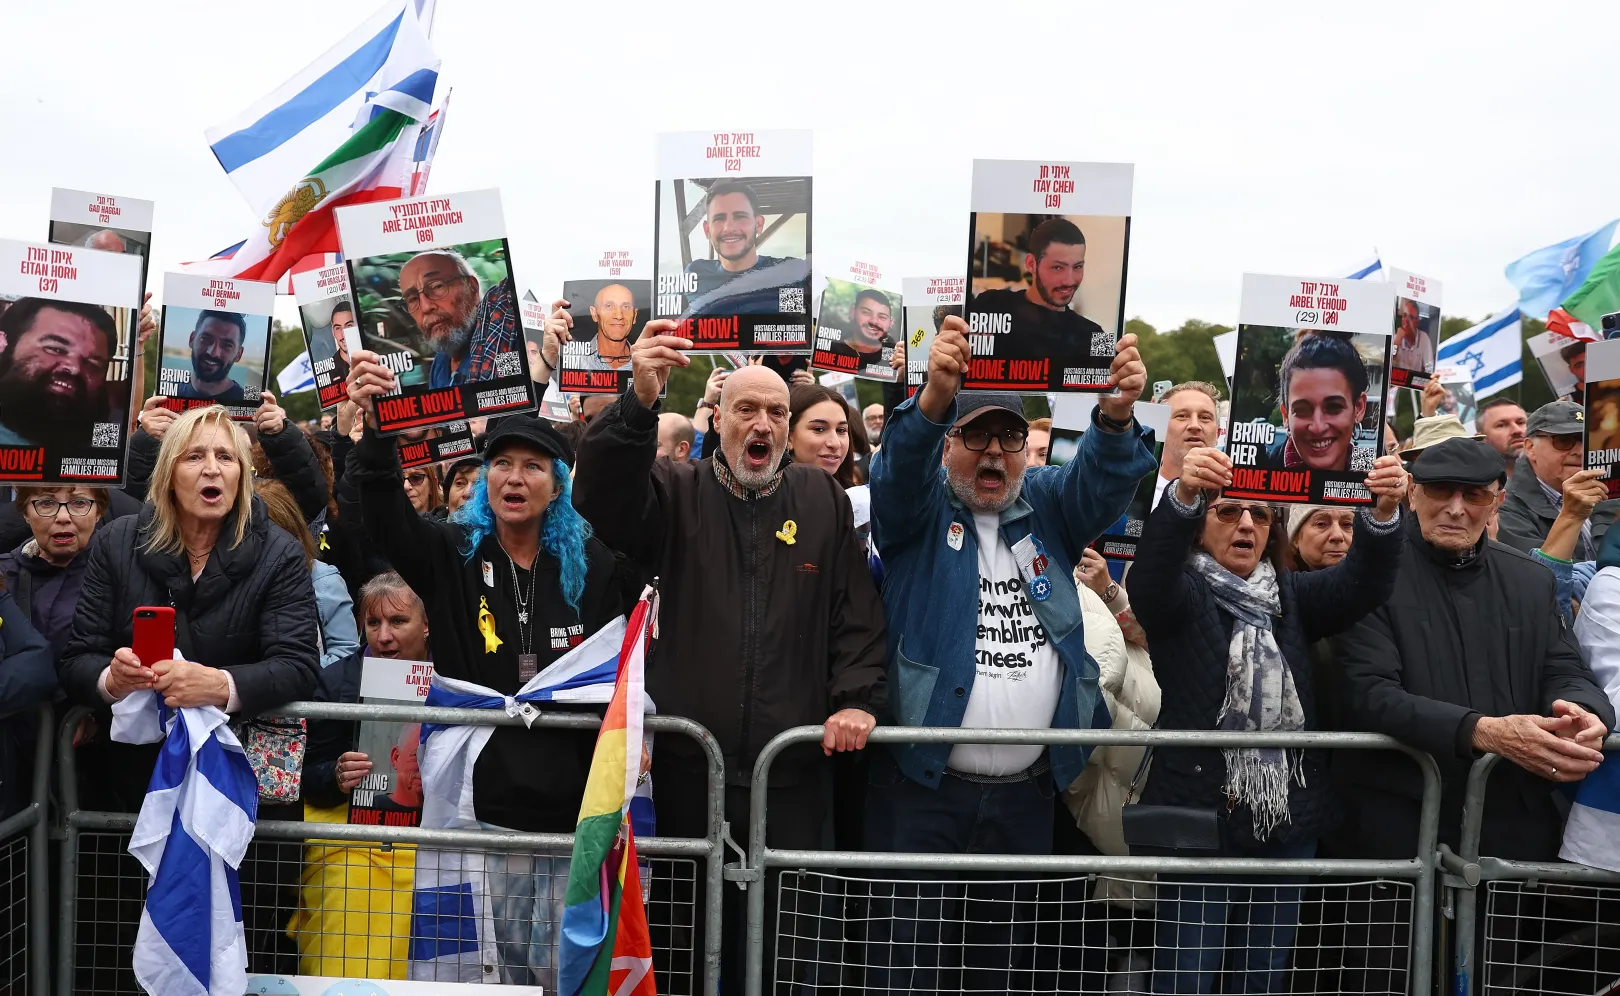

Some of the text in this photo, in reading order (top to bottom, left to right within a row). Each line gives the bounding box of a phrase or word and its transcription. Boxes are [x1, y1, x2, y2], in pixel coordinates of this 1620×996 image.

[713, 133, 754, 146] דניאל פרץ
[706, 145, 761, 158] DANIEL PEREZ
[725, 158, 741, 172] (22)
[1040, 165, 1070, 179] איתי חן
[1033, 179, 1075, 193] ITAY CHEN
[88, 203, 101, 213] GAD
[430, 199, 451, 213] אריה
[1045, 193, 1061, 208] (19)
[98, 213, 110, 223] (72)
[382, 211, 463, 233] ARIE ZALMANOVICH
[416, 228, 434, 244] (86)
[27, 246, 72, 265] איתן הורן
[20, 260, 77, 280] EITAN HORN
[38, 277, 58, 294] (37)
[658, 272, 698, 294] BRING
[926, 286, 936, 295] GUY
[1301, 281, 1339, 297] ארבל יהוד
[201, 287, 241, 300] GALI BERMAN
[214, 298, 227, 308] (26)
[657, 294, 683, 316] HIM
[1289, 294, 1347, 311] ARBEL YEHOUD
[969, 312, 1012, 334] BRING
[1295, 310, 1319, 325] (29)
[697, 315, 739, 339] NOW!
[753, 324, 806, 332] HOSTAGES AND MISSING
[818, 325, 842, 340] BRING
[753, 331, 806, 342] FAMILIES FORUM
[911, 329, 925, 347] 365
[563, 341, 591, 356] BRING
[816, 337, 832, 352] HIM
[969, 334, 994, 356] HIM
[314, 357, 336, 375] BRING
[379, 351, 414, 373] RING
[562, 355, 580, 369] HIM
[814, 350, 836, 365] HOME
[836, 354, 860, 370] NOW!
[160, 367, 191, 383] BRING
[966, 358, 1049, 381] HOME NOW!
[1063, 367, 1086, 375] HOSTAGES
[316, 372, 331, 388] HIM
[561, 371, 589, 385] HOME
[590, 371, 618, 387] NOW!
[908, 372, 923, 385] HIM
[1063, 374, 1091, 385] FAMILIES
[159, 381, 178, 397] HIM
[320, 384, 341, 401] HOME
[476, 385, 527, 399] HOSTAGES AND MISSING
[378, 387, 463, 422] HOME NOW!
[477, 392, 529, 409] FAMILIES FORUM
[1232, 421, 1275, 445] BRING
[402, 440, 431, 462] NOW!
[1230, 443, 1258, 466] HER
[1588, 448, 1620, 465] BRIN
[61, 457, 118, 467] HOSTAGES AND MISSING
[60, 464, 117, 477] FAMILIES FORUM
[1269, 469, 1311, 493] NOW!
[1324, 480, 1346, 489] HOSTAGES
[1345, 481, 1355, 489] AND
[1323, 487, 1372, 500] FAMILIES FORUM
[550, 627, 568, 638] BRING
[551, 637, 570, 649] HOME
[412, 664, 425, 675] וייס
[405, 674, 421, 685] ILAN
[352, 789, 375, 807] HIM
[351, 808, 417, 827] HOME NOW!
